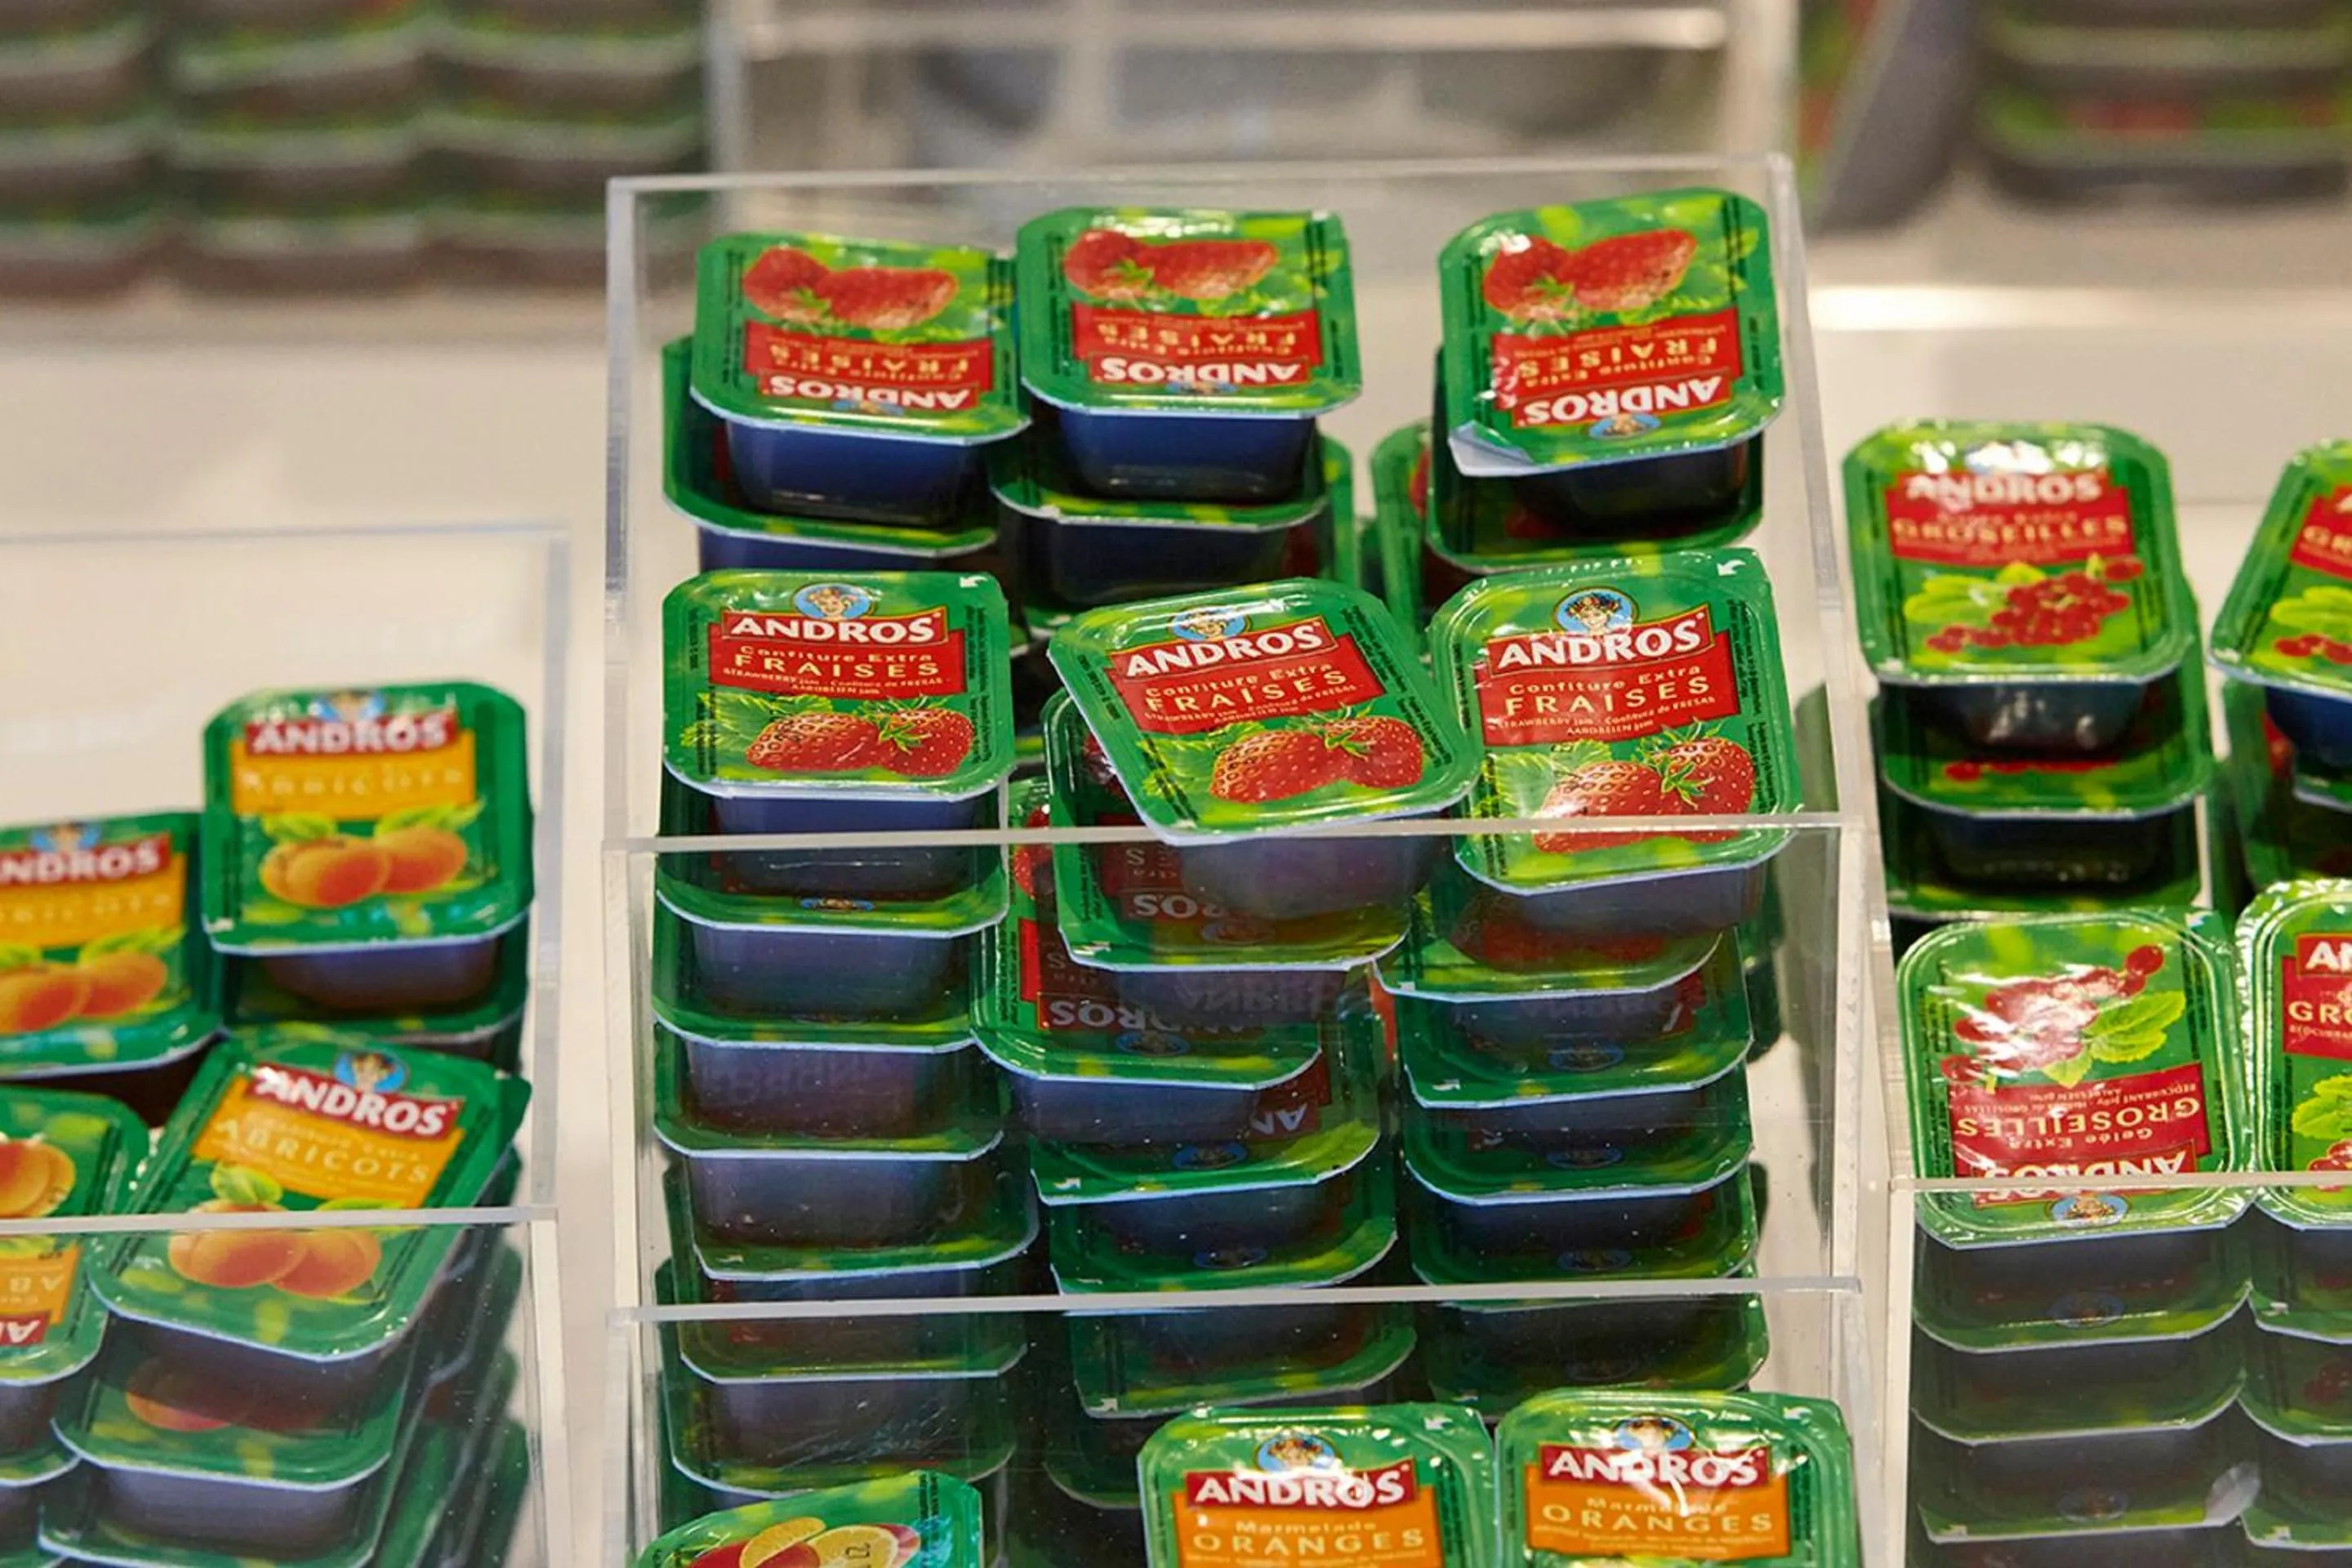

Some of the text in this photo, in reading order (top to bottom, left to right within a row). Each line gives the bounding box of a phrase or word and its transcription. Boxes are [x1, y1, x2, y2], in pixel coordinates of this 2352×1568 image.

[1101, 358, 1302, 383] ANDROS
[1519, 338, 1717, 377] FRAISES
[768, 376, 970, 408] ANDROS
[1524, 376, 1722, 423] ANDROS
[732, 617, 934, 644] ANDROS
[1499, 620, 1701, 668] ANDROS
[735, 654, 940, 678] FRAISES
[740, 645, 933, 663] Confiture Extra
[1127, 625, 1322, 676] ANDROS
[1146, 674, 1258, 697] Confiture
[1147, 670, 1347, 711] FRAISES
[1505, 675, 1710, 715] FRAISES
[1509, 664, 1701, 694] Confiture Extra
[252, 712, 448, 753] ANDROS
[0, 838, 159, 884] NDROS
[251, 1067, 447, 1135] ANDROS
[1957, 1096, 2200, 1138] GROSEILLES
[214, 1119, 430, 1183] ABRICOTS
[1196, 1468, 1405, 1508] ANDROS
[1549, 1450, 1759, 1487] ANDROS
[1236, 1519, 1377, 1534] Marmelade
[1543, 1503, 1774, 1535] ORANGES
[1193, 1529, 1425, 1556] ORANGES
